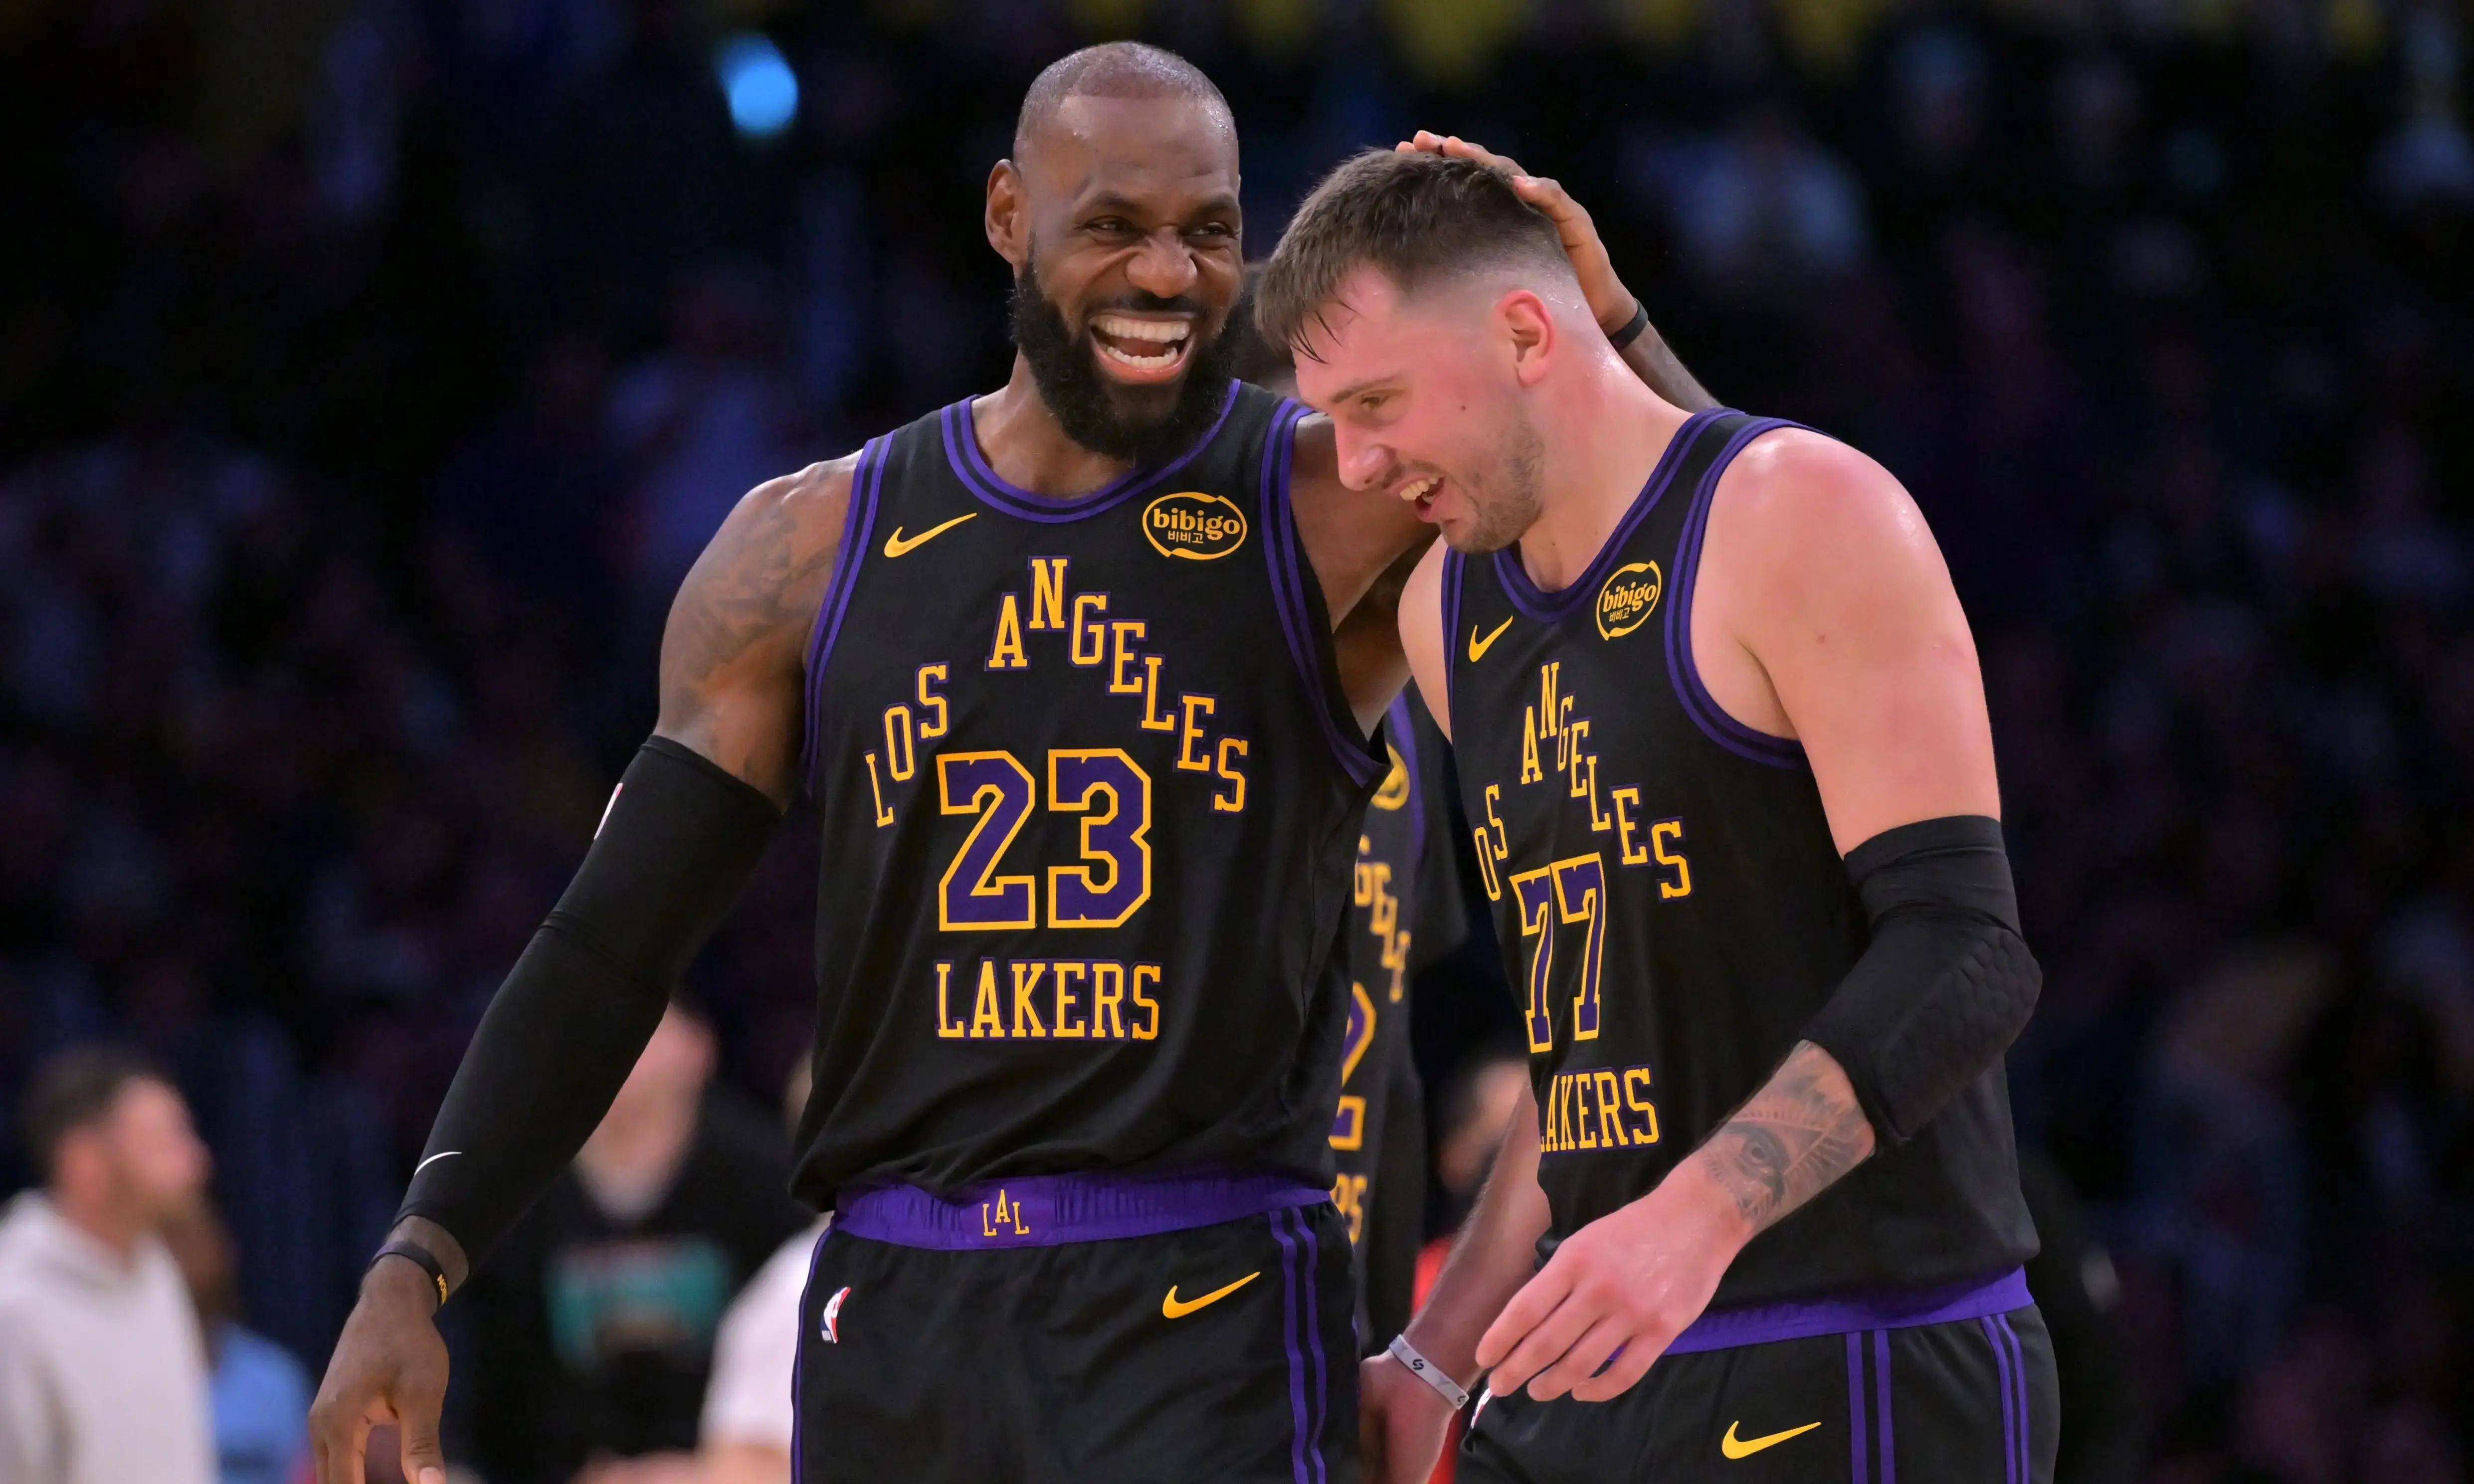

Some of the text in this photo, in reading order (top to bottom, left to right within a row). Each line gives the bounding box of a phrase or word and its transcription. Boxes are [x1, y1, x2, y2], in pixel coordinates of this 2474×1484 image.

[1153, 507, 1241, 541] bibigo
[1167, 530, 1204, 544] 비비고
[1602, 581, 1657, 612] bibigo
[1609, 607, 1631, 623] 비비고
[865, 558, 1249, 828] LOS ANGELES
[1473, 661, 1692, 902] OS ANGELES
[936, 748, 1152, 932] 23
[1508, 851, 1606, 1055] 77
[936, 960, 1161, 1041] LAKERS
[983, 1189, 1030, 1237] LAL
